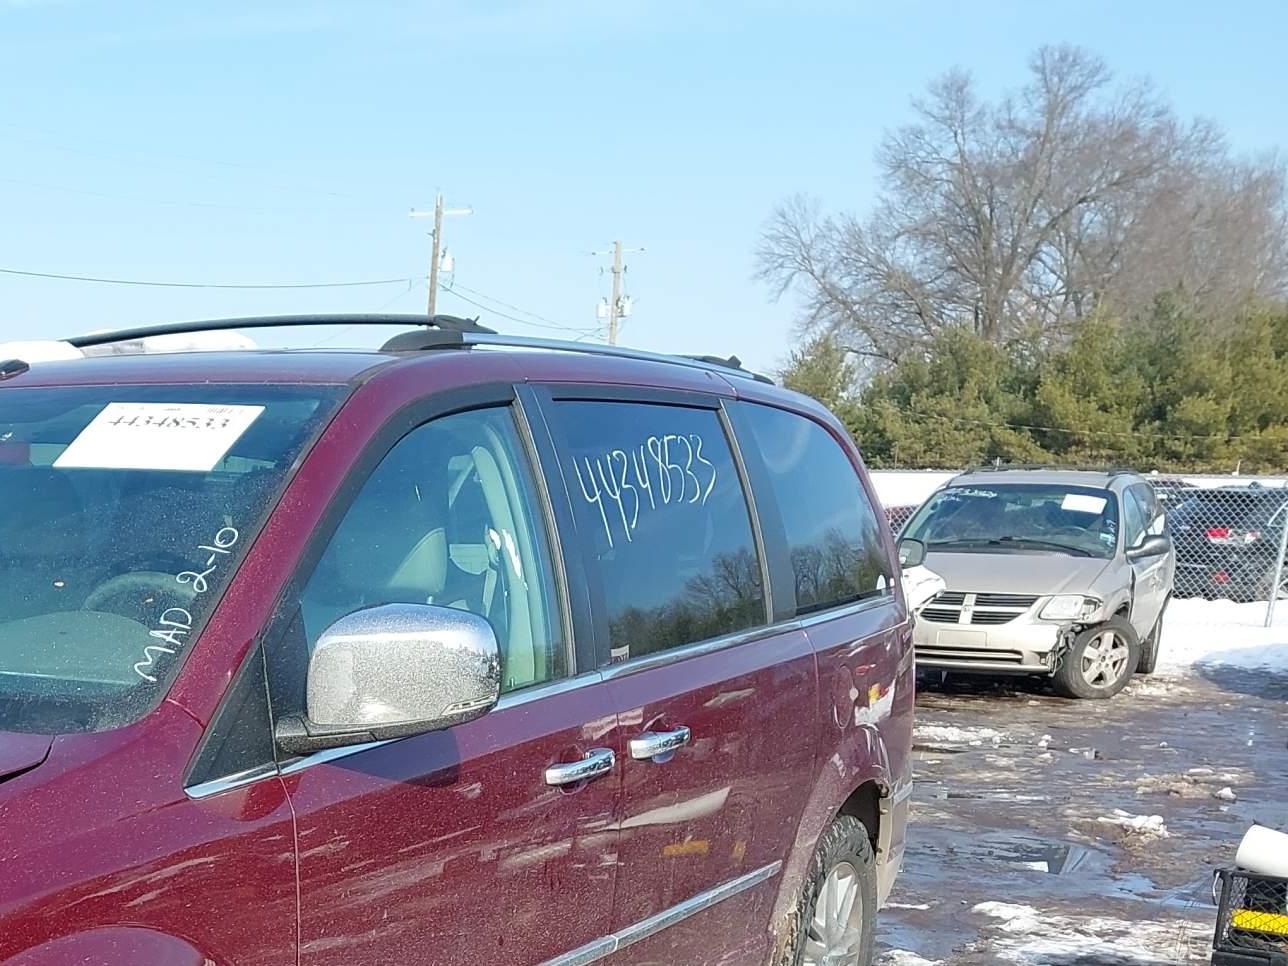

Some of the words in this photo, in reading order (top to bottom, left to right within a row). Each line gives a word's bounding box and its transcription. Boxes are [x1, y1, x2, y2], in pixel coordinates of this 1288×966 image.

[108, 415, 231, 430] 44348533
[571, 434, 717, 548] 44348533
[133, 606, 193, 682] MAD
[175, 526, 239, 592] 2-10
